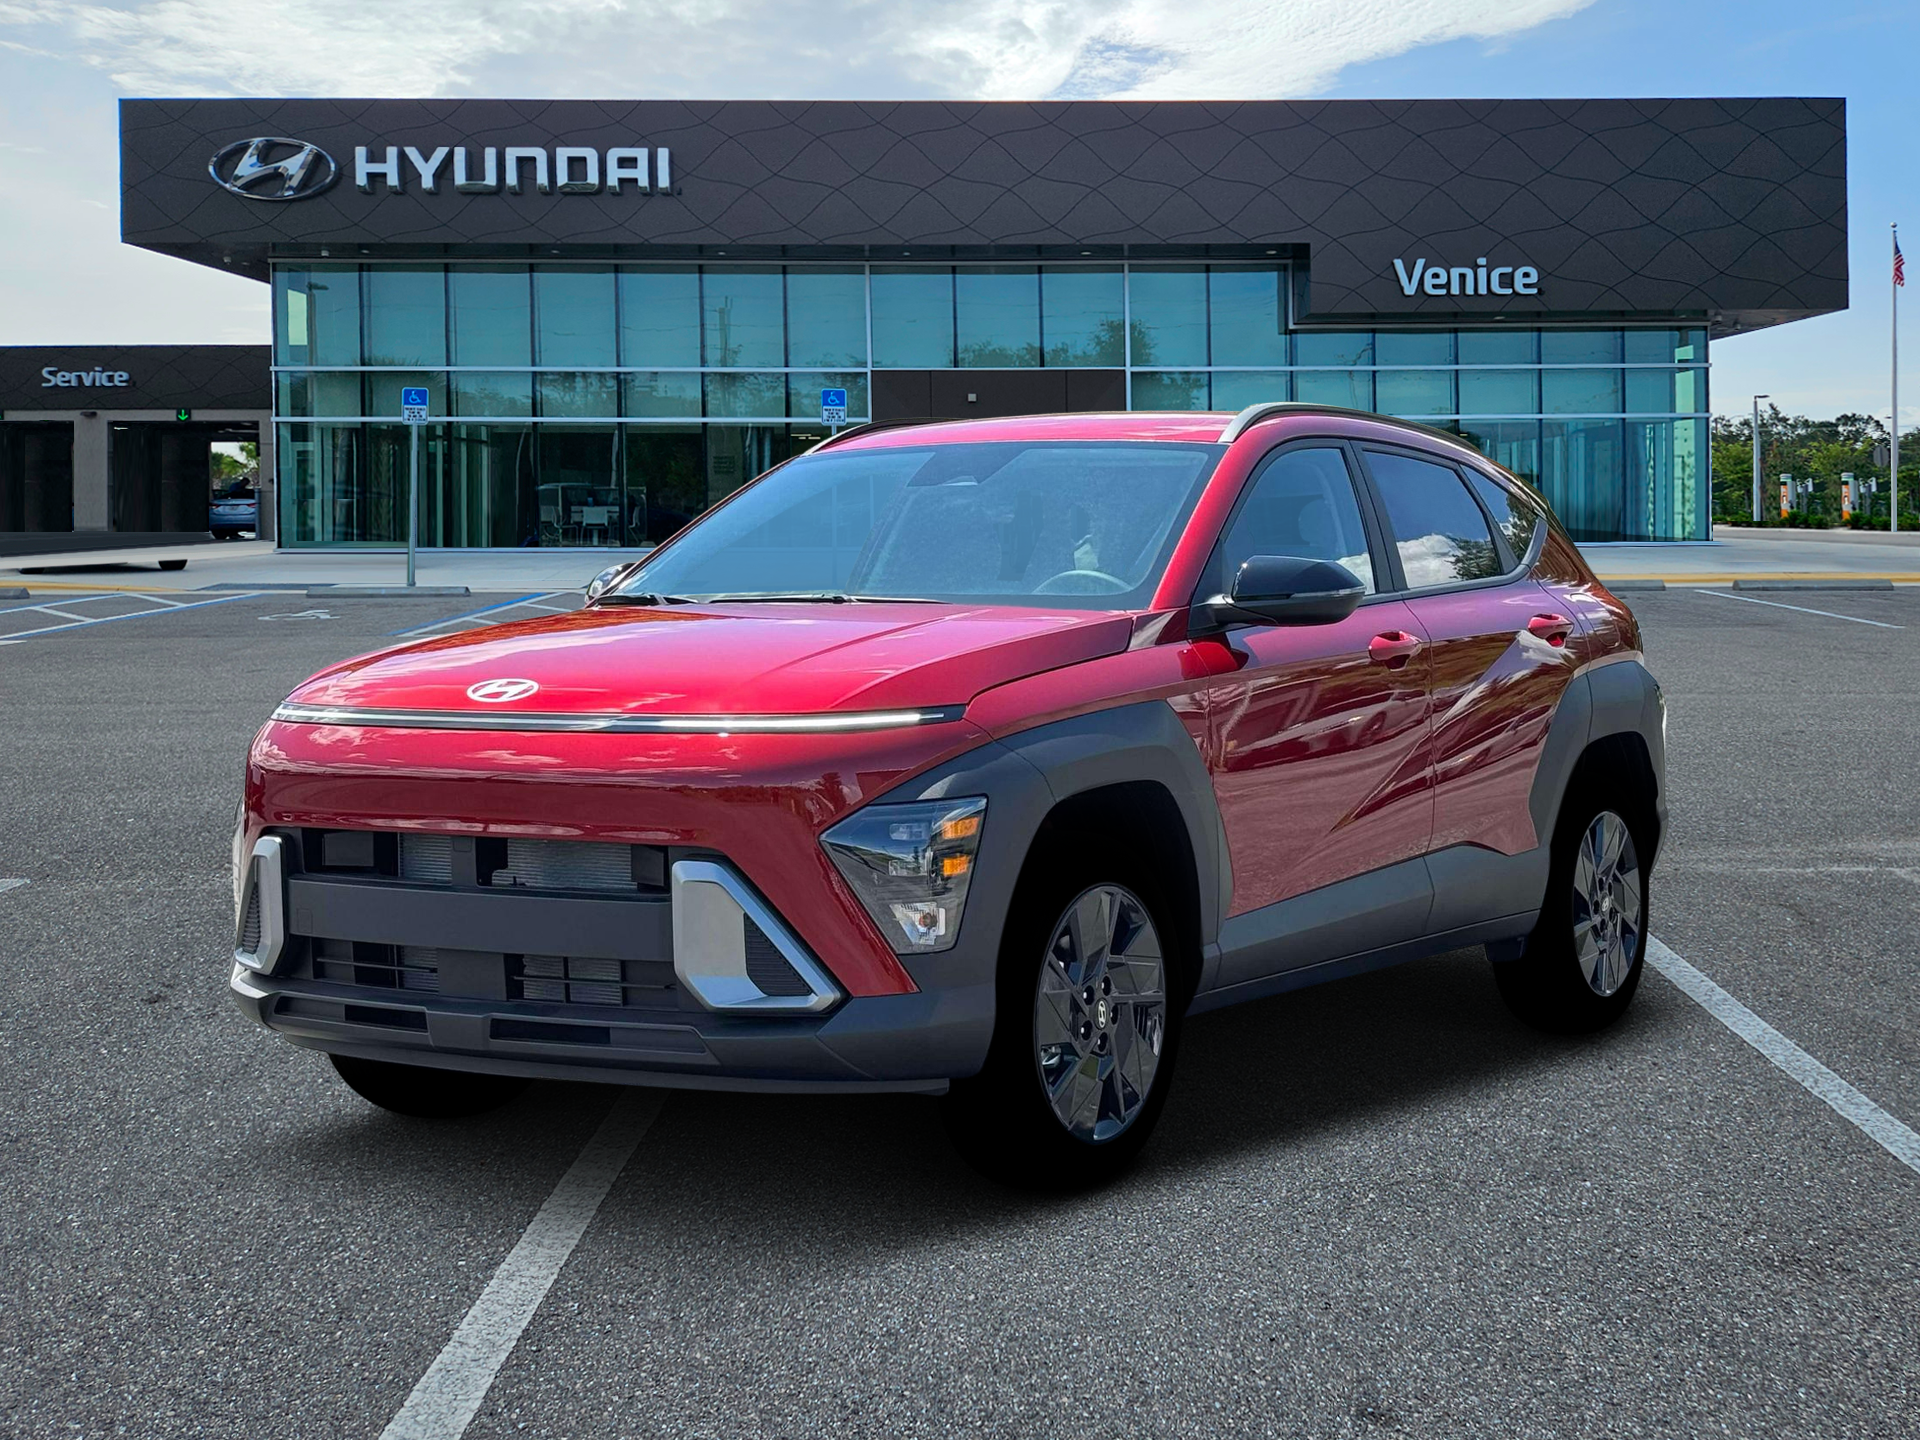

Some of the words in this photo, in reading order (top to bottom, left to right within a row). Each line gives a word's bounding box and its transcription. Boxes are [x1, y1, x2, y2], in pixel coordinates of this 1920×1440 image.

[354, 145, 672, 194] HYUNDAI
[1393, 257, 1539, 296] Venice
[41, 366, 130, 387] Service
